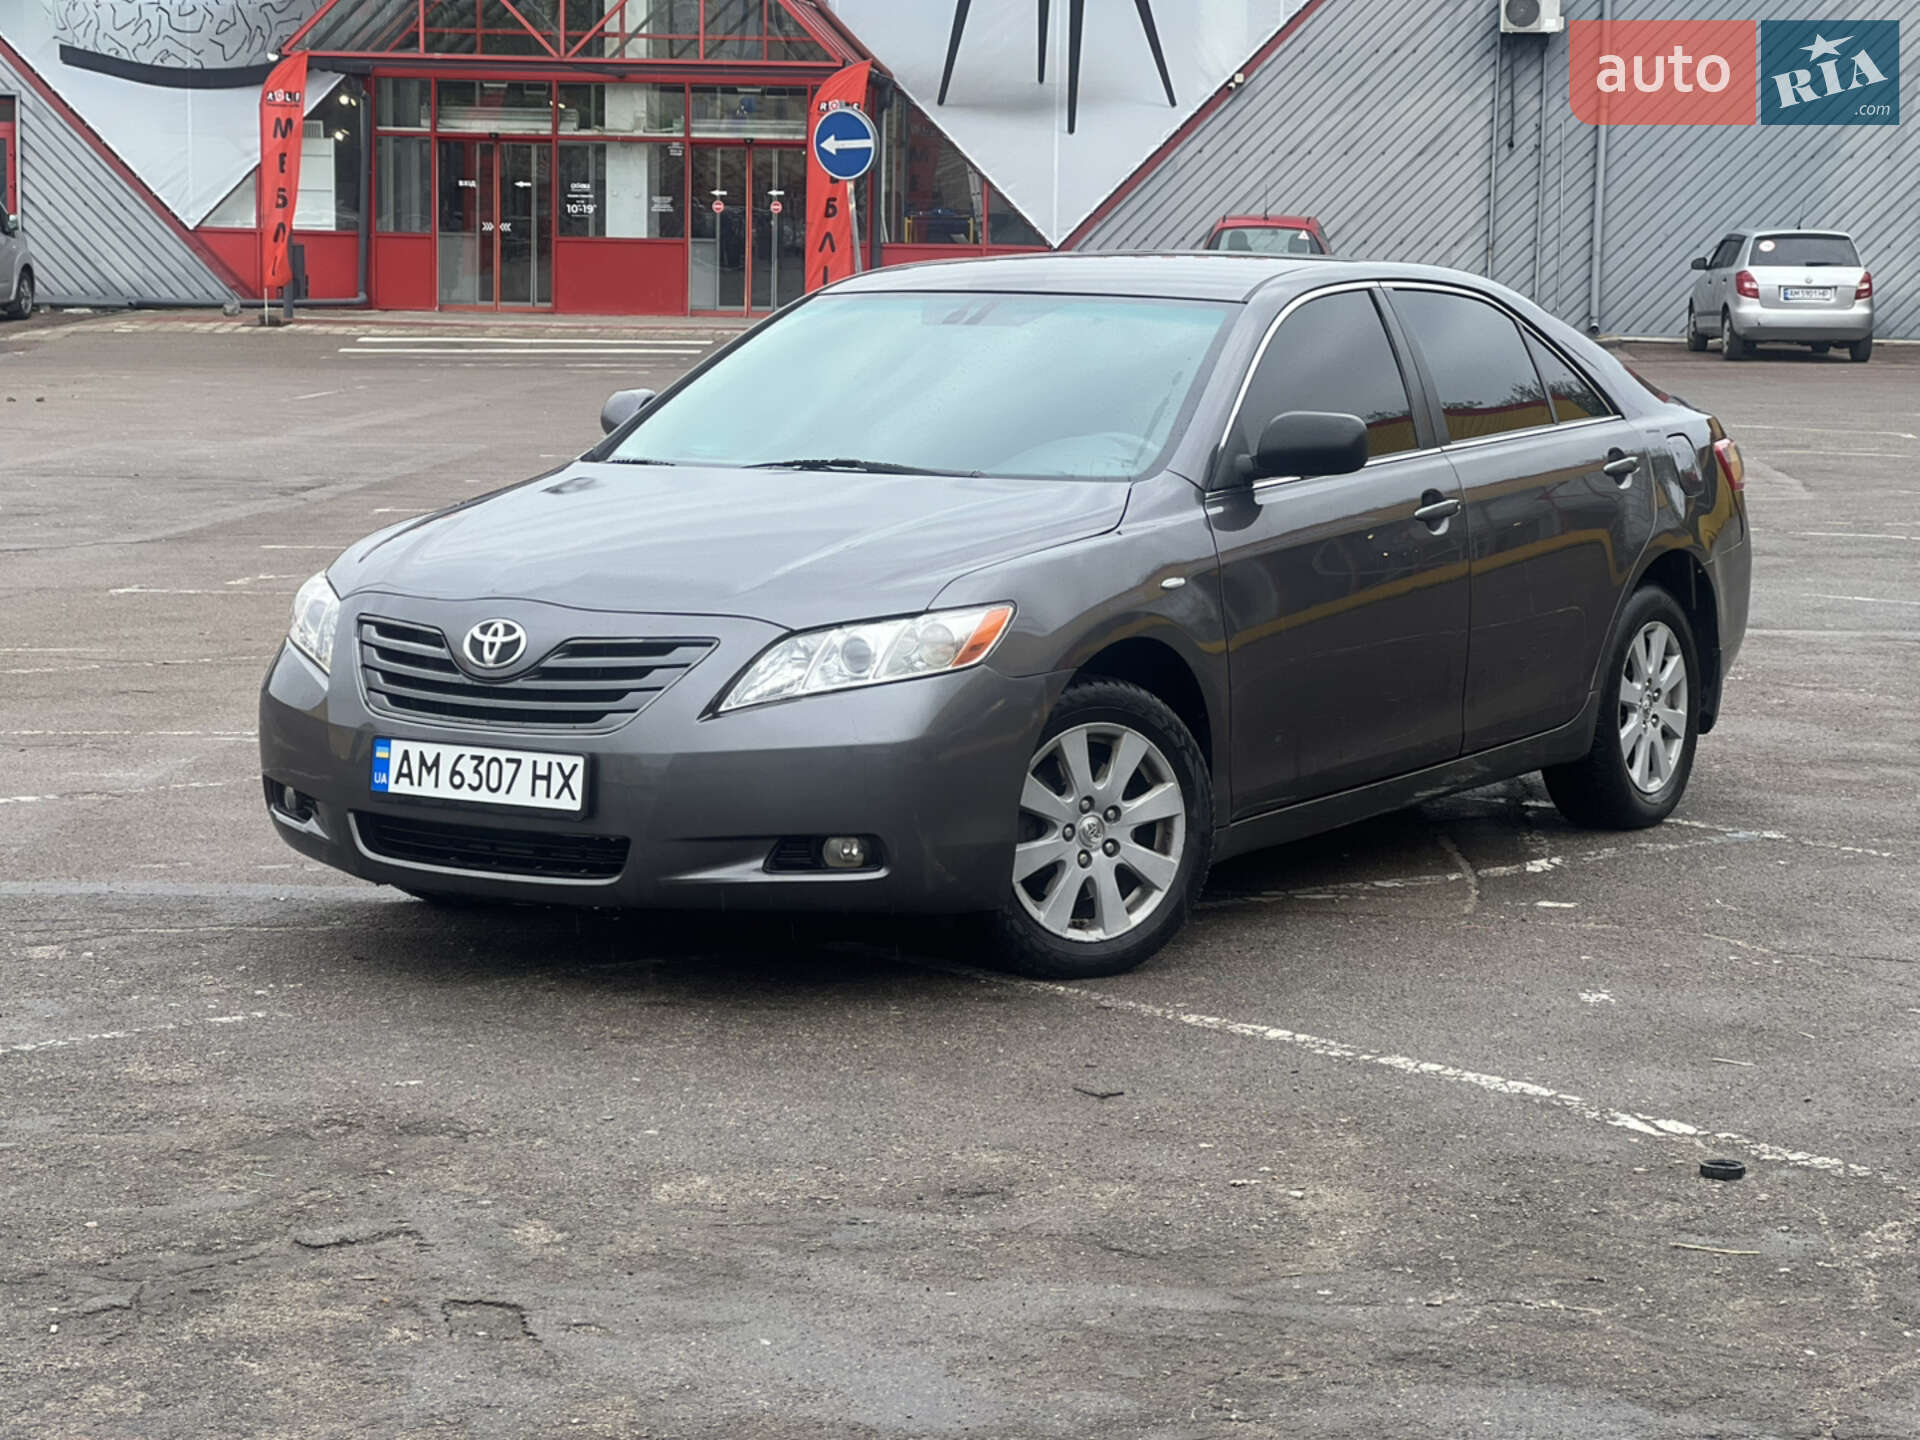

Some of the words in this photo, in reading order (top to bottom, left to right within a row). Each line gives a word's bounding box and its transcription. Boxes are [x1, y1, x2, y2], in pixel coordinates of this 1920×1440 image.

[273, 117, 294, 277] МЕБЛІ
[374, 771, 387, 784] UA
[394, 749, 441, 788] AM
[449, 753, 522, 795] 6307
[531, 759, 579, 801] HX
